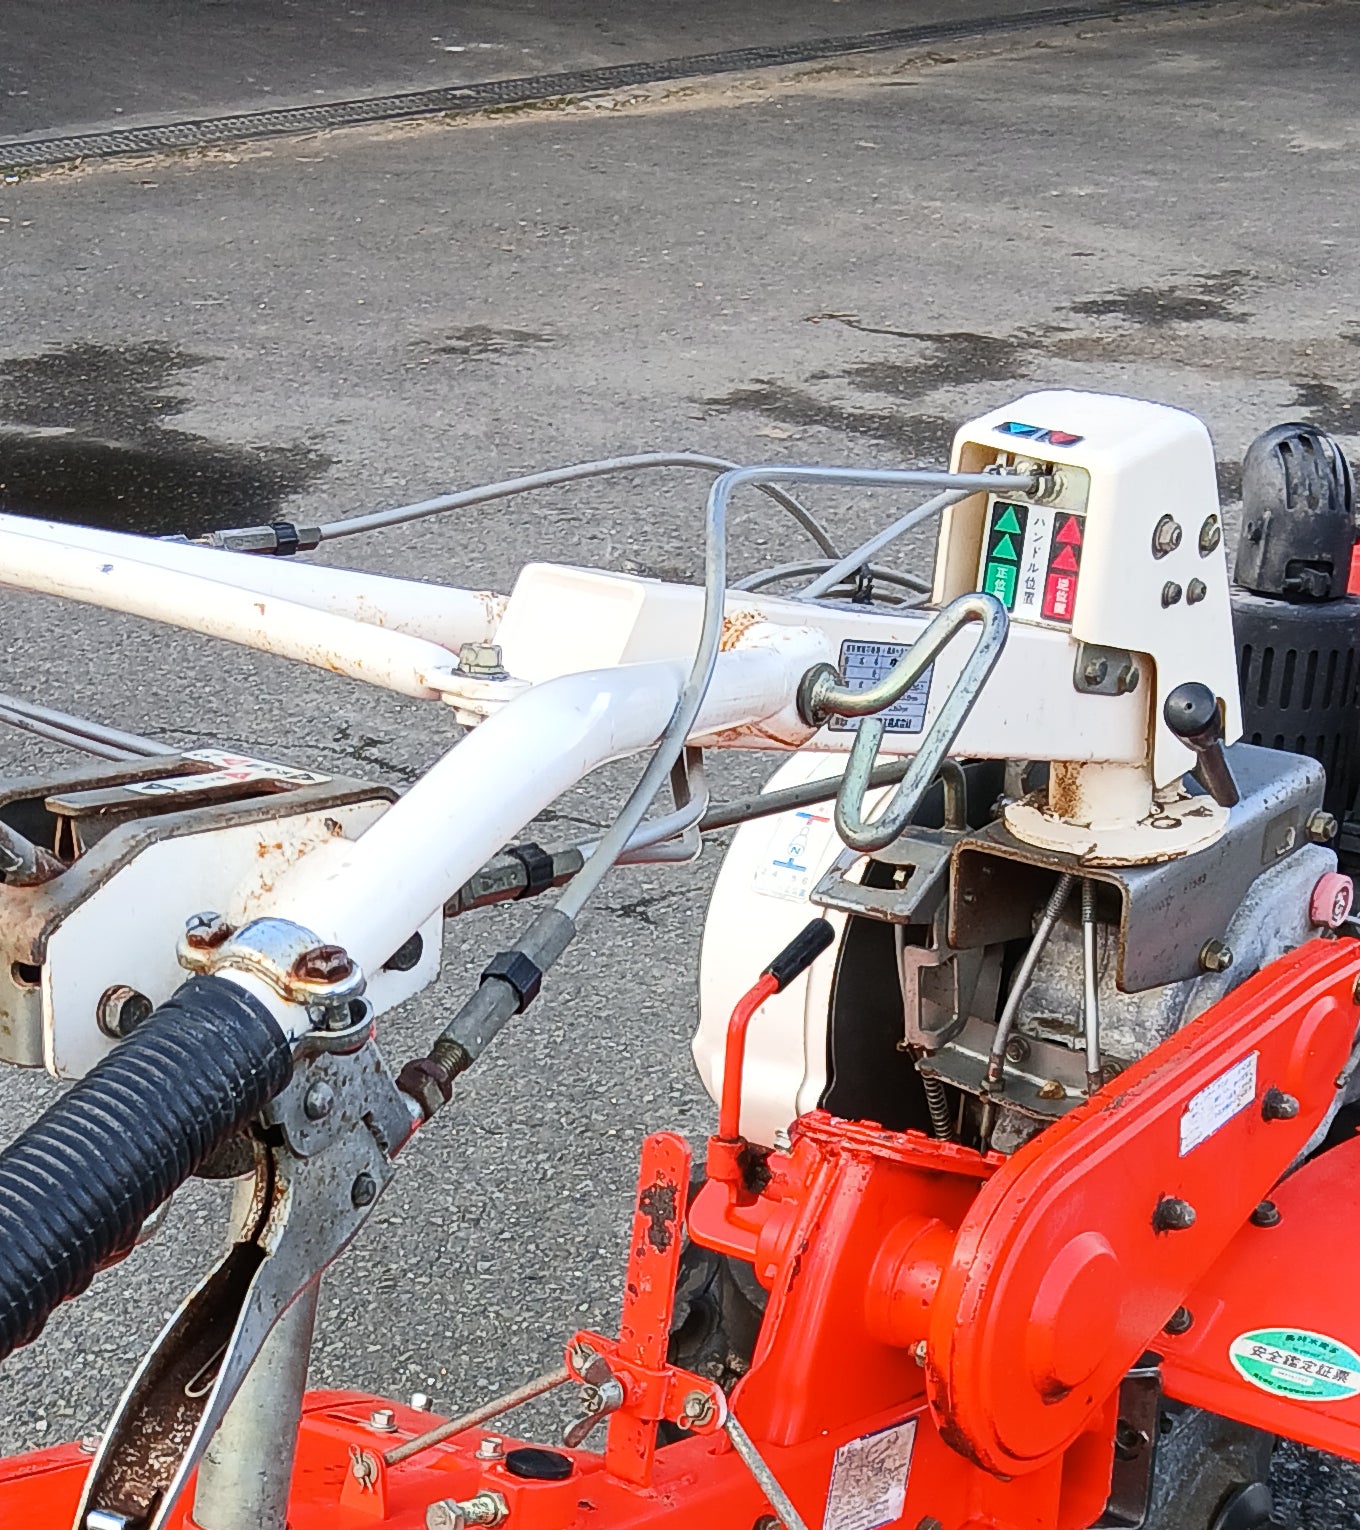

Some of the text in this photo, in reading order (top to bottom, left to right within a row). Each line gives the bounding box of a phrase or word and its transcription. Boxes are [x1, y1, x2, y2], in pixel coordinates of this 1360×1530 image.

[1024, 518, 1046, 604] ハンドル位置
[1250, 1345, 1351, 1383] 安全鑑定証票
